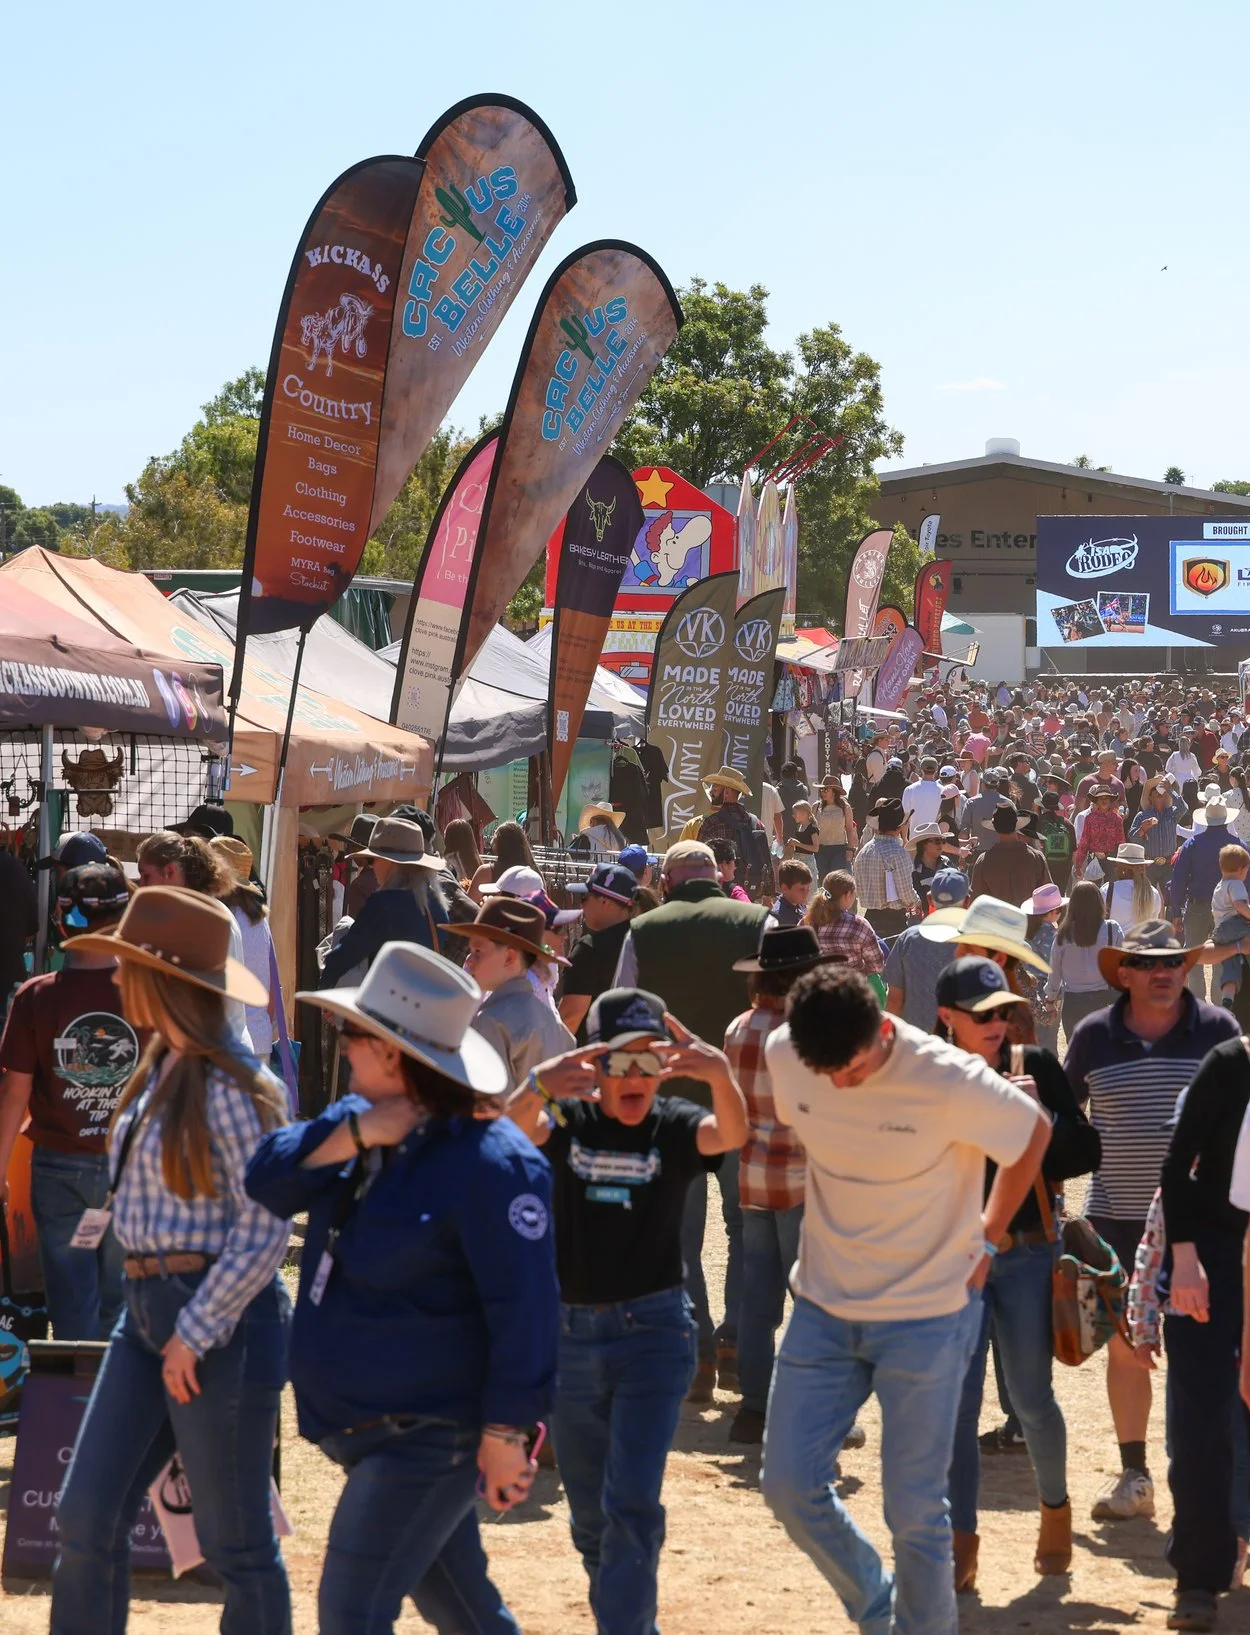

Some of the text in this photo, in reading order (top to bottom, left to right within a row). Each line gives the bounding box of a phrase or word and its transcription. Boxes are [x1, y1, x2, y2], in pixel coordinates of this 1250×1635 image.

[517, 193, 532, 213] 2014
[305, 245, 391, 293] KICKASS
[432, 205, 527, 333] BELLE
[451, 312, 484, 357] Western
[477, 271, 510, 315] Clothing
[512, 209, 543, 264] Accessories
[624, 318, 639, 335] 2014
[564, 328, 629, 436] BELLE
[283, 374, 372, 425] Country
[572, 420, 597, 456] Western
[592, 385, 618, 421] Clothing
[287, 425, 361, 456] Home Decor
[308, 457, 337, 476] Bags
[295, 481, 347, 506] Clothing
[282, 504, 357, 532] Accessories
[290, 530, 346, 553] Footwear
[1213, 526, 1248, 535] BROUGHT
[290, 557, 321, 572] MYRA
[1079, 550, 1135, 572] RODEO
[289, 572, 330, 592] Stockist
[616, 621, 625, 630] US
[627, 621, 637, 630] AT
[639, 621, 653, 630] THE
[685, 613, 720, 642] VK
[858, 598, 870, 636] ULLET
[742, 624, 772, 649] VK
[663, 664, 720, 685] MADE
[889, 651, 918, 700] NOW OPEN
[660, 682, 720, 705] North
[726, 681, 765, 704] North
[658, 704, 717, 722] LOVED
[724, 714, 760, 726] ERYWHERE
[726, 701, 761, 718] OVED
[657, 719, 715, 731] EVERYWHERE
[731, 734, 750, 768] INYL
[75, 1098, 120, 1111] AT THE
[89, 1111, 109, 1122] TIP
